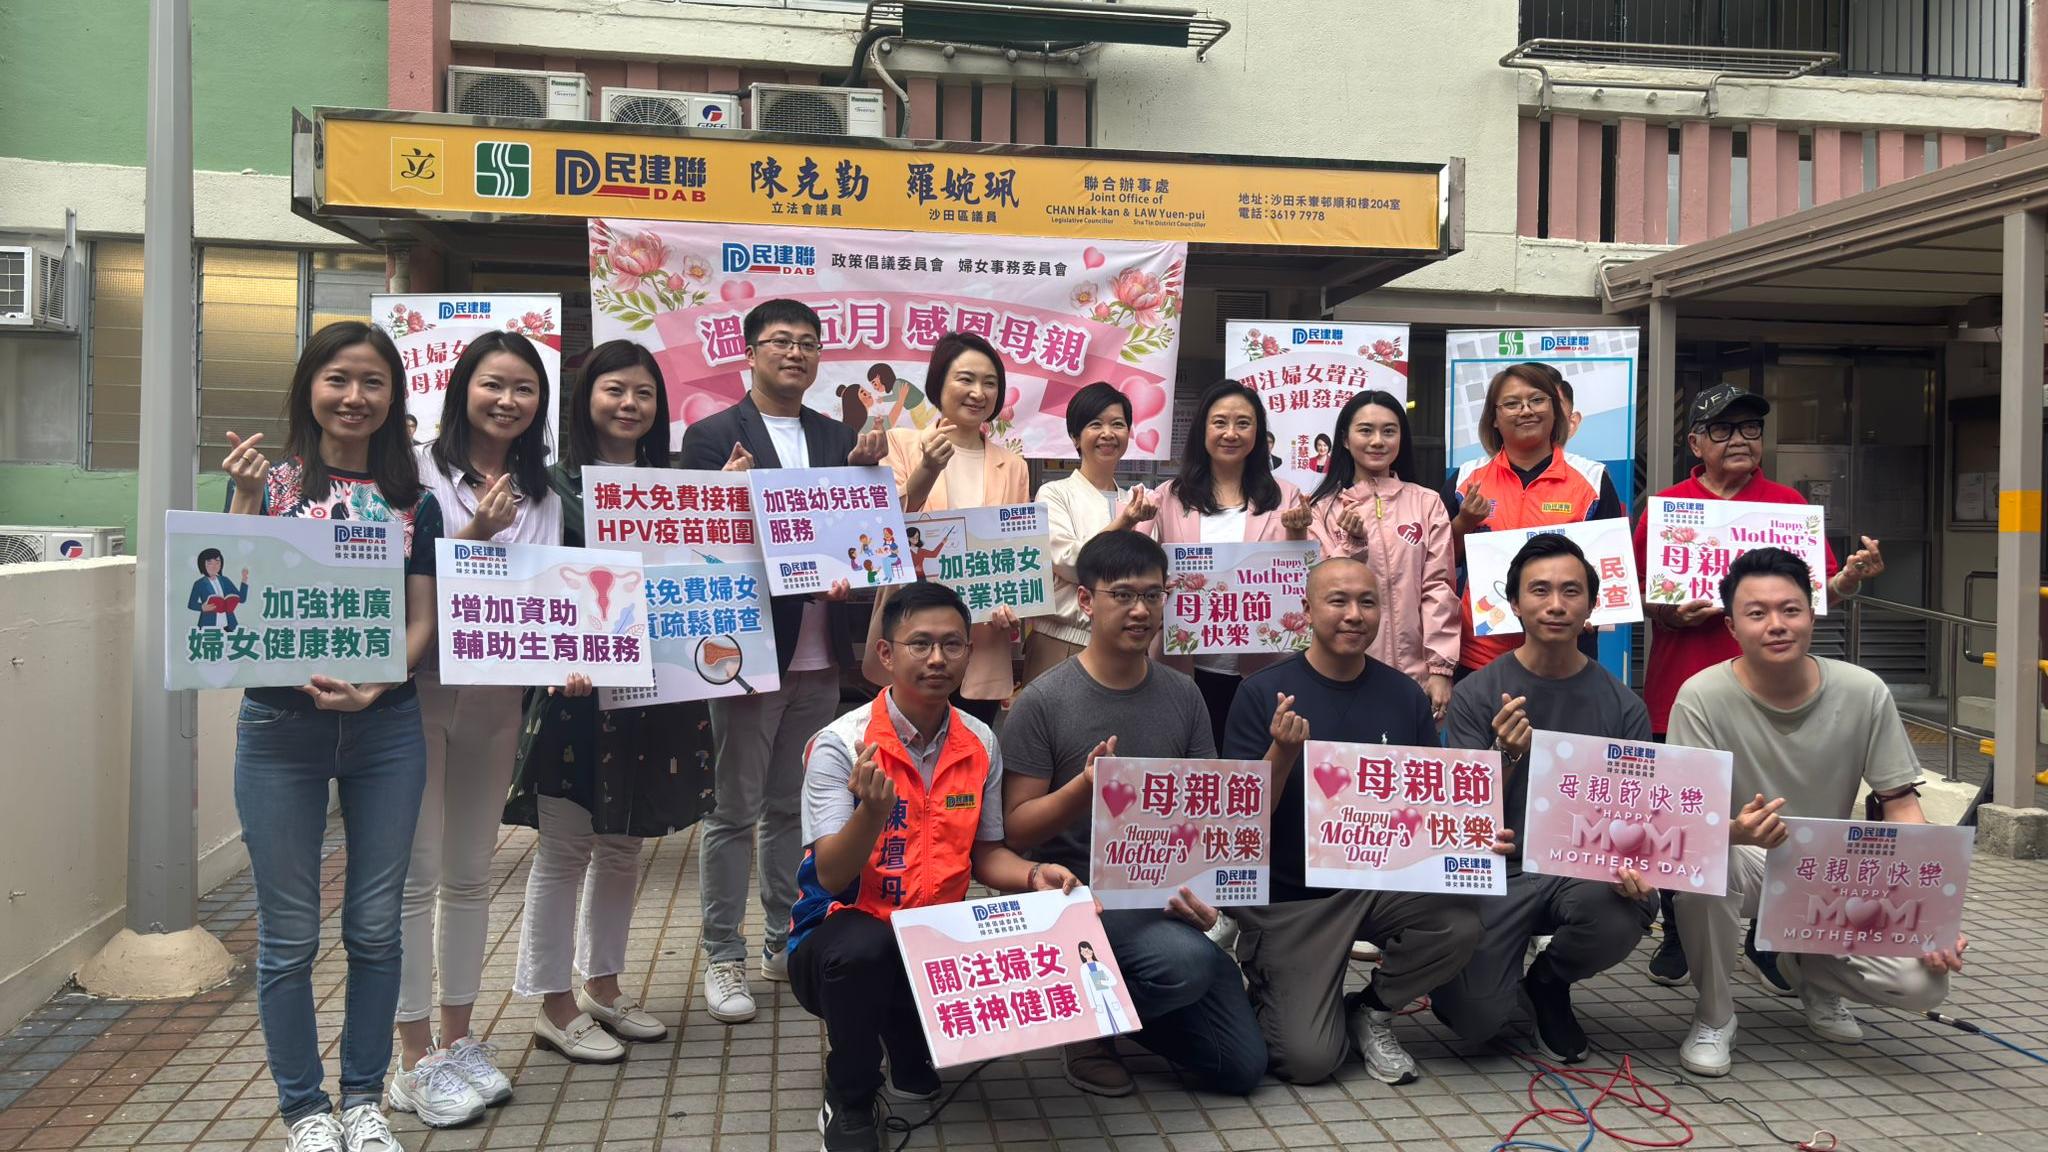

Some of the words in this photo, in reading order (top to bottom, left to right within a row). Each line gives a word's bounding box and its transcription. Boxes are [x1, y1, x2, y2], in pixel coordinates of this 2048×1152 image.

[605, 152, 707, 187] 民建聯
[750, 156, 869, 201] 陳克勤
[907, 163, 1020, 209] 羅婉珮
[1084, 176, 1169, 193] 聯合辦事處
[654, 189, 707, 203] DAB
[1090, 192, 1116, 202] Joint
[1119, 193, 1149, 204] Office
[1152, 195, 1163, 204] of
[772, 202, 843, 217] 立法會議員
[929, 208, 998, 224] 沙田區議員
[1046, 205, 1076, 216] CHAN
[1077, 206, 1120, 217] Hak-kan
[1123, 208, 1130, 217] &
[1134, 207, 1157, 218] LAW
[1160, 209, 1205, 221] Yuen-pui
[1300, 210, 1325, 221] 7978
[751, 244, 816, 267] 民建聯
[831, 253, 944, 274] 政策倡議委員會
[958, 257, 1068, 278] 婦女事務委員會
[782, 266, 816, 276] DAB
[455, 302, 491, 315] 民建聯
[700, 302, 888, 361] 溫五月
[906, 304, 1088, 372] 感恩母親
[1308, 328, 1343, 340] 民建聯
[1557, 336, 1589, 346] 民建聯
[405, 368, 454, 399] 母親
[594, 482, 751, 513] 擴大免費接種
[763, 484, 890, 514] 加強幼兒託管
[1677, 501, 1704, 510] 民建聯
[1011, 506, 1035, 516] 民建聯
[351, 526, 386, 539] 民建聯
[598, 517, 755, 545] HPV疫苗範圍
[769, 517, 815, 545] 服務
[1730, 527, 1817, 546] Mother's
[1770, 520, 1804, 532] Happy
[471, 546, 506, 557] 民建聯
[1187, 547, 1213, 556] 民建聯
[1660, 544, 1745, 577] 母親
[791, 561, 817, 571] 民建聯
[939, 546, 1041, 580] 加強婦女
[1273, 558, 1302, 568] Happy
[1237, 567, 1309, 585] Mother'
[262, 586, 391, 619] 加強推廣
[1597, 584, 1630, 608] 查
[451, 593, 577, 627] 增加資助
[1174, 591, 1272, 624] 母親節
[188, 626, 392, 662] 婦女健康教育
[452, 630, 640, 663] 輔助生育服務
[1201, 624, 1250, 647] 快樂
[1624, 745, 1655, 759] 民建聯
[1357, 757, 1492, 805] 母親節
[1142, 773, 1262, 816] 母親節
[1558, 774, 1704, 815] 母親節快樂
[1341, 806, 1389, 828] Happy
[1603, 809, 1653, 823] HAPPY
[1125, 825, 1169, 845] Happy
[1321, 821, 1411, 848] Mother's
[1427, 813, 1495, 848] 快樂
[1864, 827, 1897, 838] 民建聯
[1106, 840, 1188, 865] Mother's
[1202, 827, 1261, 860] 快樂
[1345, 846, 1388, 869] Day!
[1460, 857, 1491, 869] 民建聯
[1550, 848, 1650, 871] MOTHER'S
[1661, 862, 1702, 876] DAY
[1128, 865, 1166, 885] Day!
[1230, 870, 1257, 880] 民建聯
[1795, 858, 1943, 888] 母親節快樂
[1840, 888, 1890, 898] HAPPY
[987, 900, 1021, 914] 民建聯
[1783, 927, 1883, 942] MOTHER'S
[1894, 932, 1936, 945] DAY
[924, 943, 1067, 996] 關注婦女
[936, 982, 1081, 1039] 精神健康
